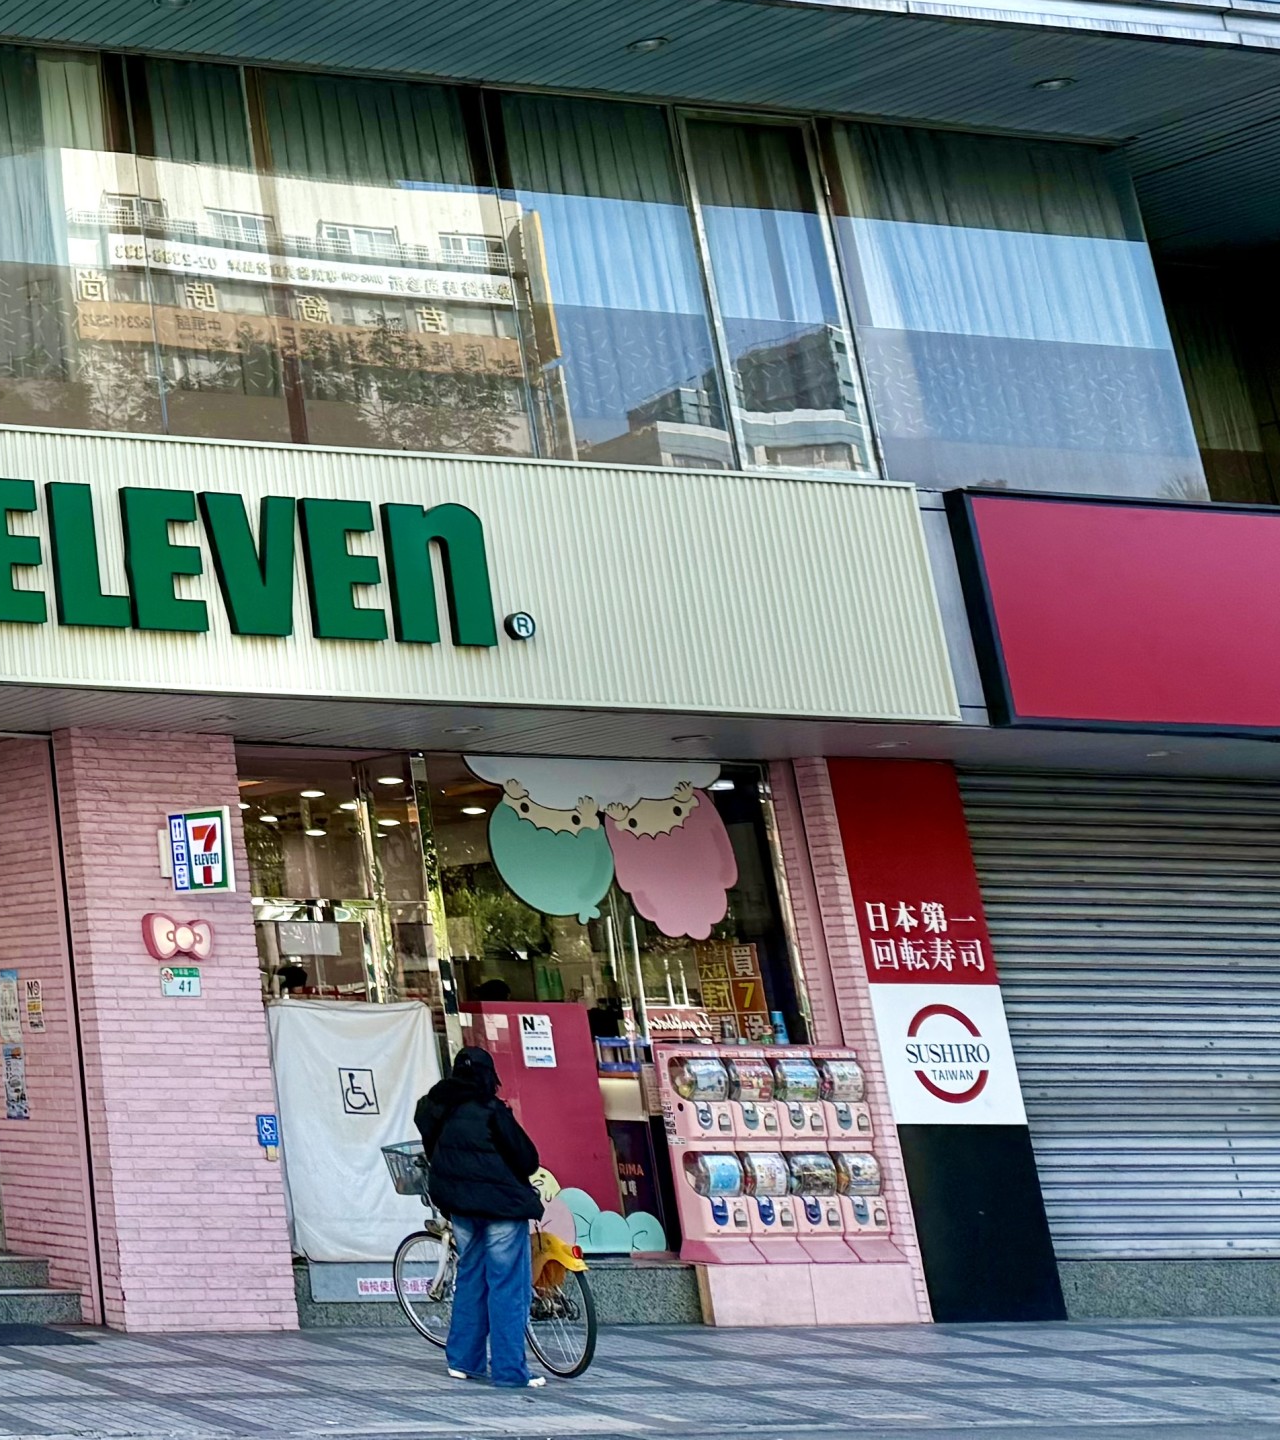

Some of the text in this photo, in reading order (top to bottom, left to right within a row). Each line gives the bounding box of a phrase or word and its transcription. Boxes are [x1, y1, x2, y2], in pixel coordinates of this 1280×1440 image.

[864, 901, 978, 933] 日本第一
[872, 936, 986, 973] 回転寿司
[178, 979, 192, 993] 41
[905, 1042, 991, 1065] SUSHIRO
[930, 1067, 975, 1082] TAIWAN
